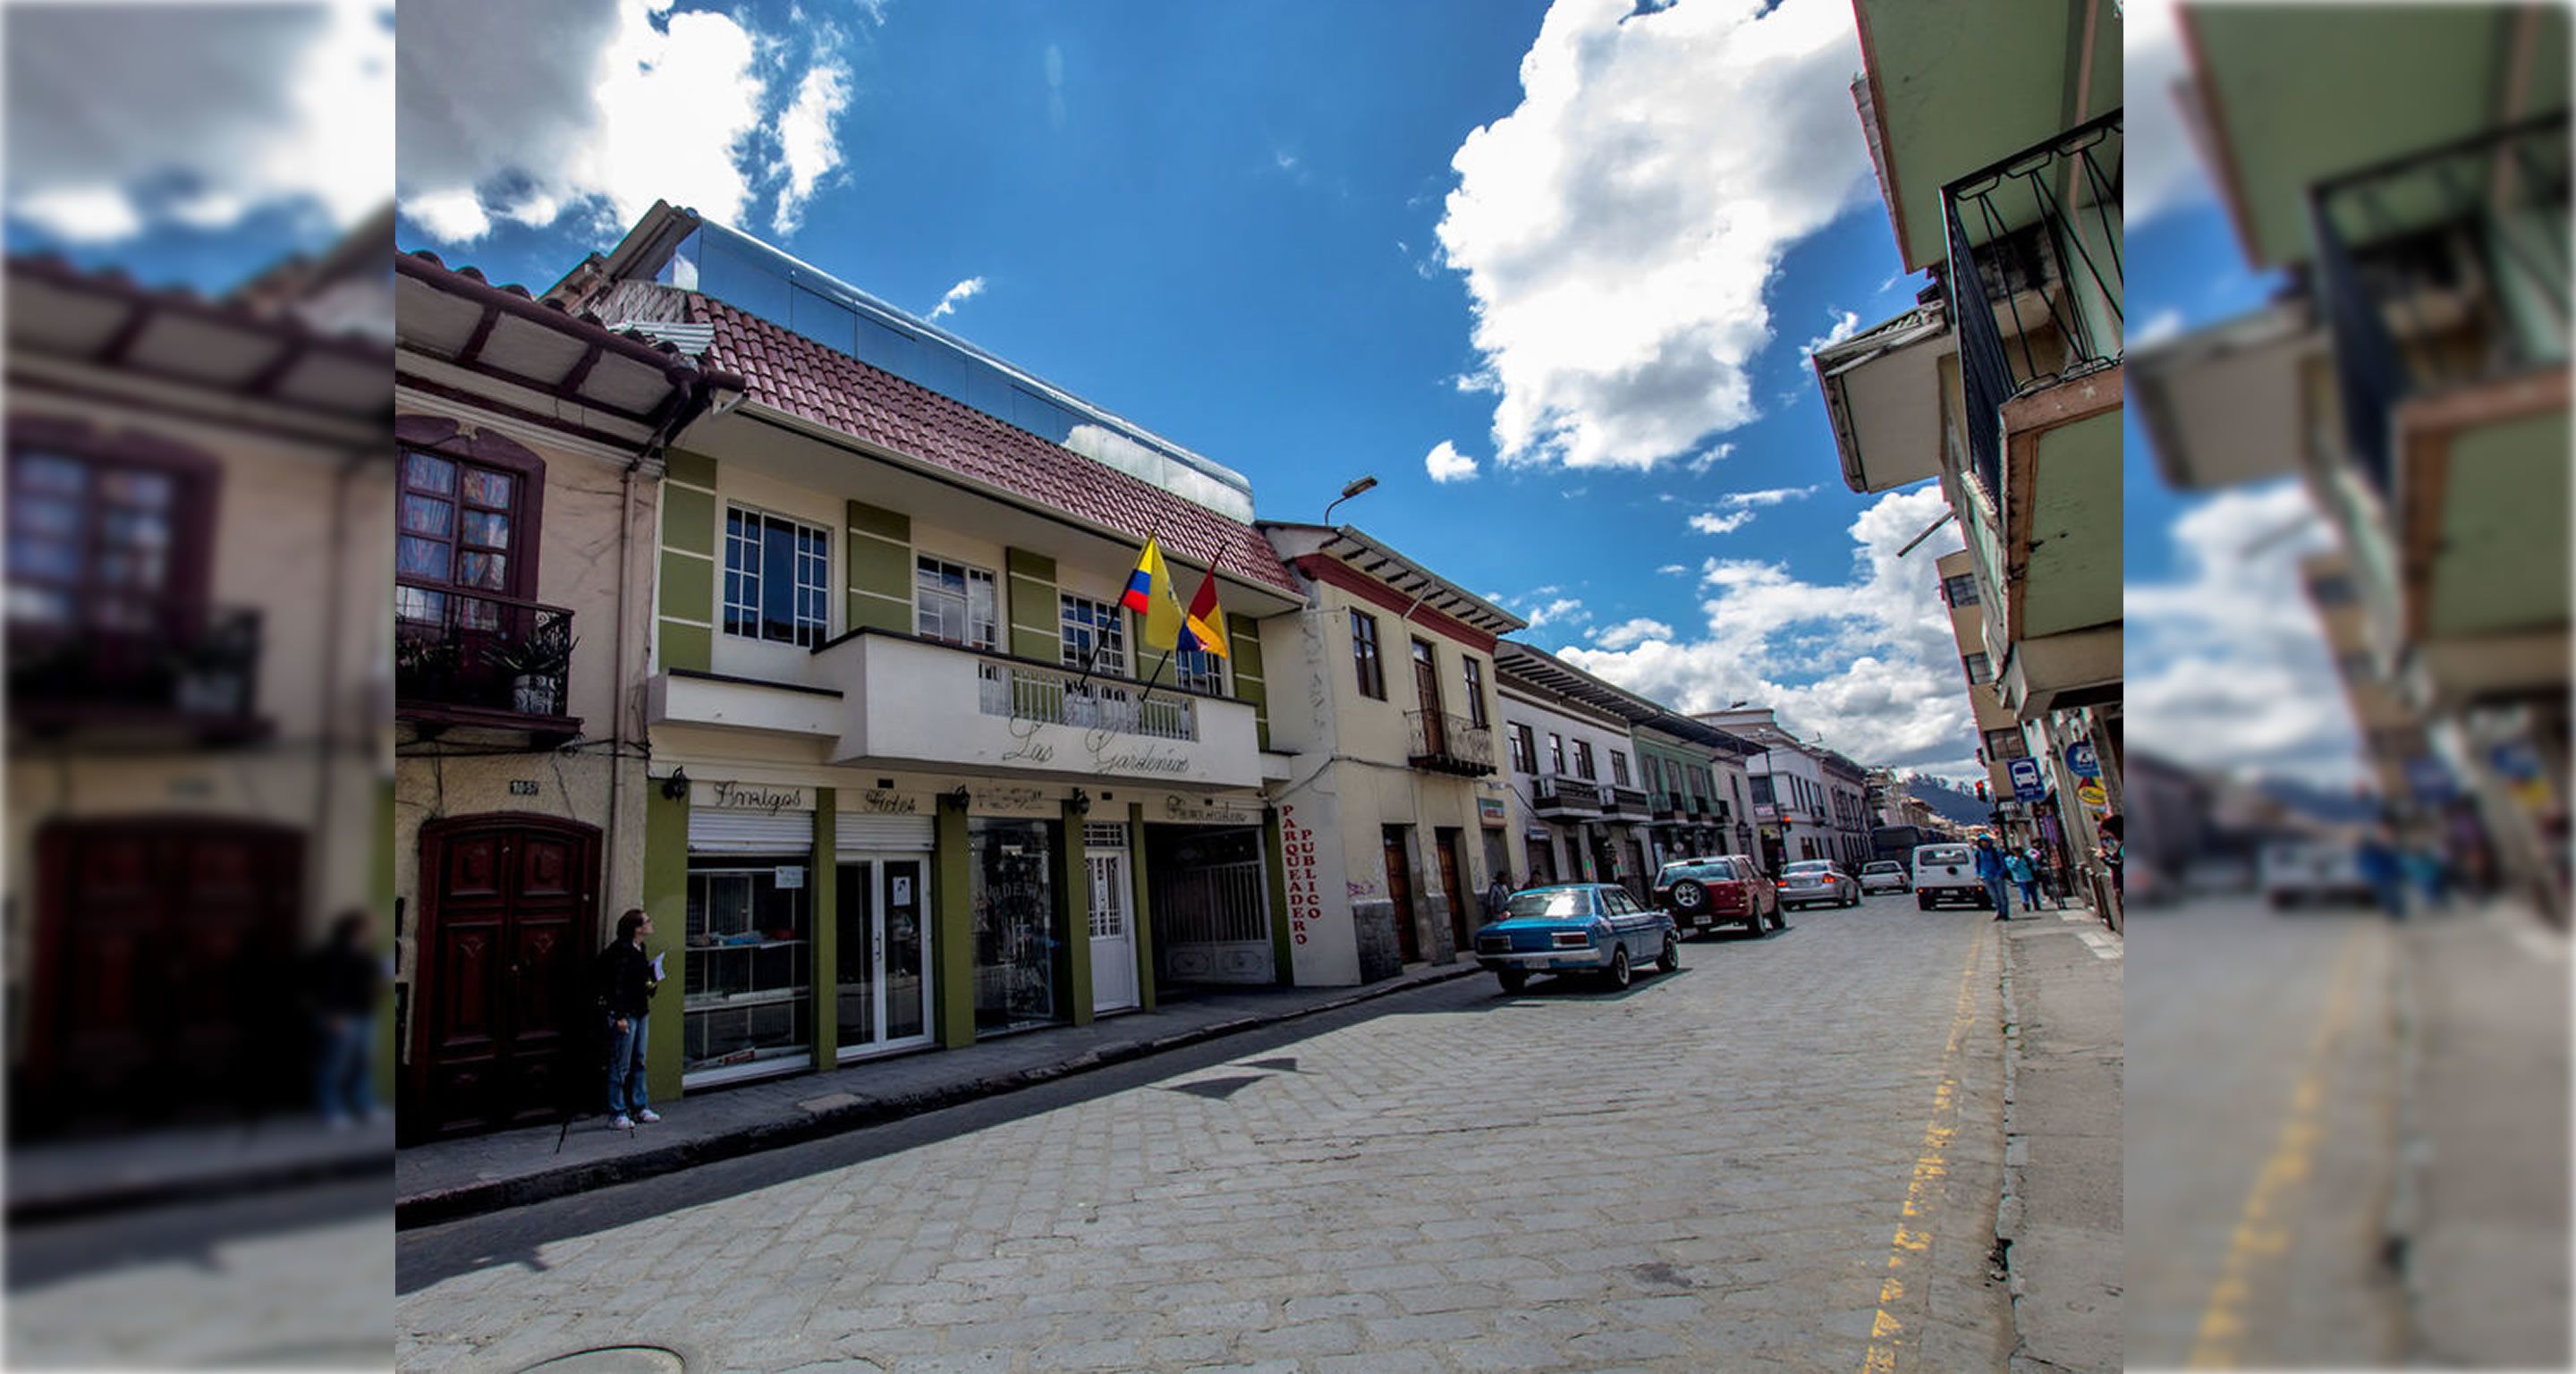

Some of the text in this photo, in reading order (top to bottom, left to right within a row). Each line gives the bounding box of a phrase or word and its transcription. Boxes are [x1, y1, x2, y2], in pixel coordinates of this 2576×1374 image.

[1002, 715, 1190, 776] Las Gardenias
[714, 781, 801, 816] Amigos
[1282, 805, 1321, 946] PARQUEADERO PUBLICO
